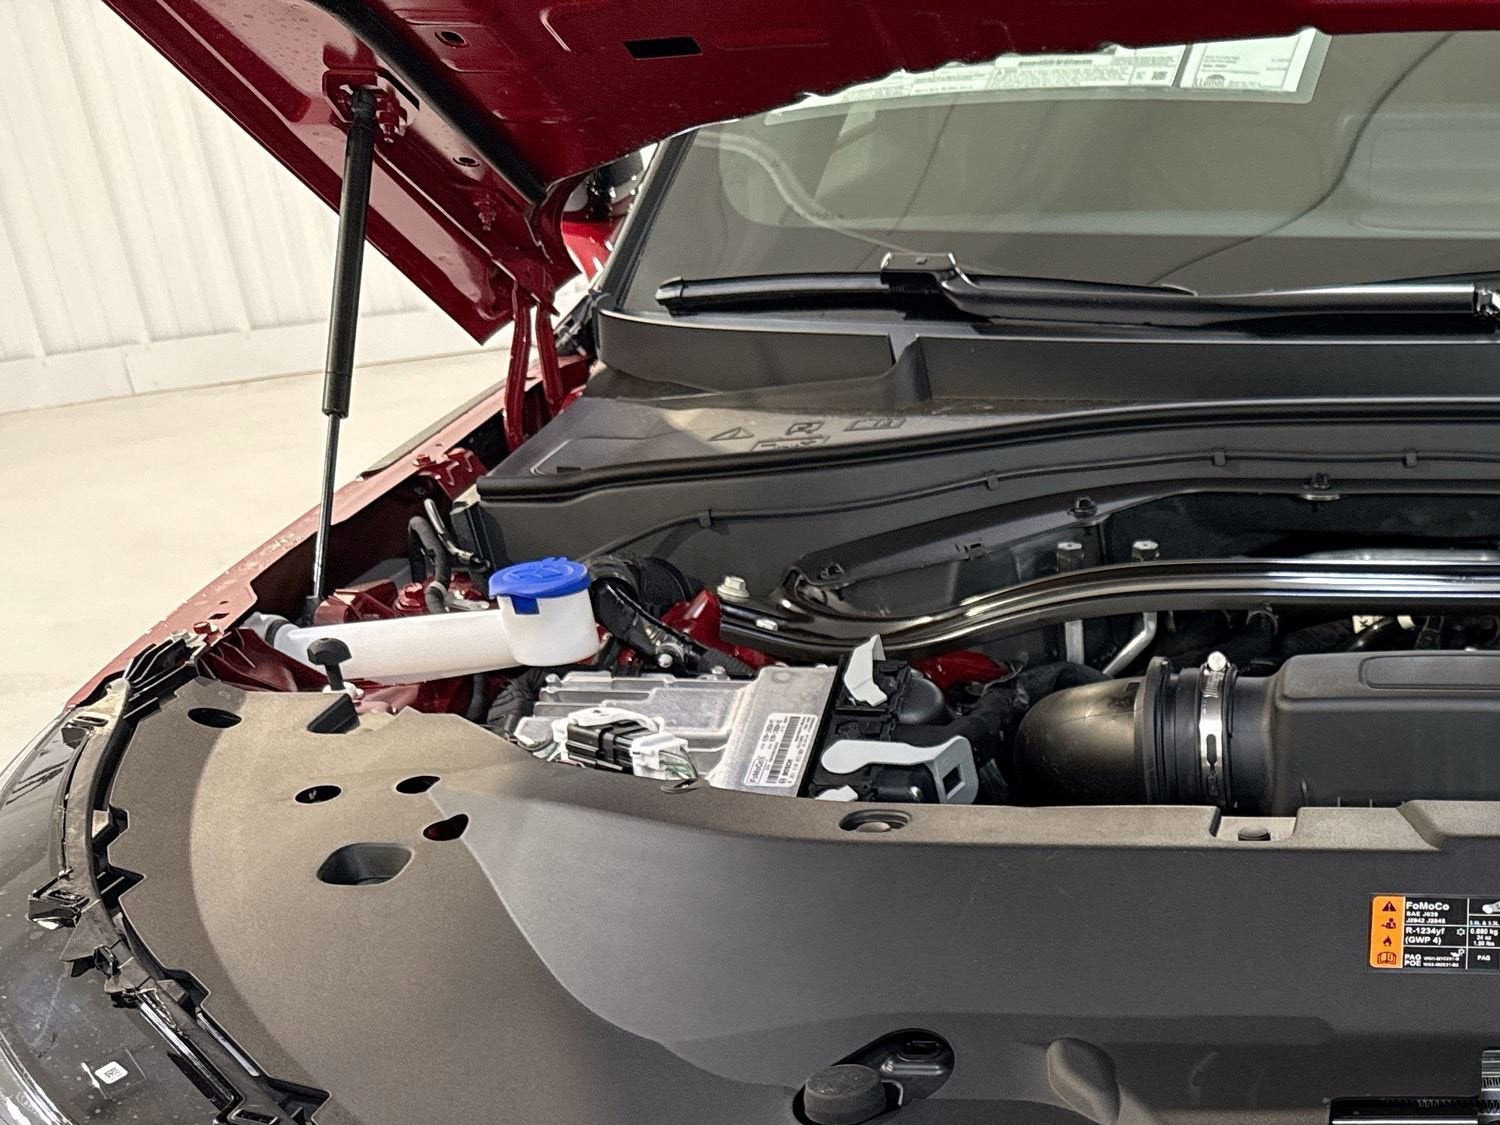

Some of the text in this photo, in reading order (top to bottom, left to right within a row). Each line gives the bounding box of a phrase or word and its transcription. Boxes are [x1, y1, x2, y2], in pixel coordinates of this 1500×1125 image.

[1406, 901, 1450, 910] FoMoCo
[1405, 927, 1446, 936] R-1234yf
[1405, 936, 1442, 945] (GWP 4)
